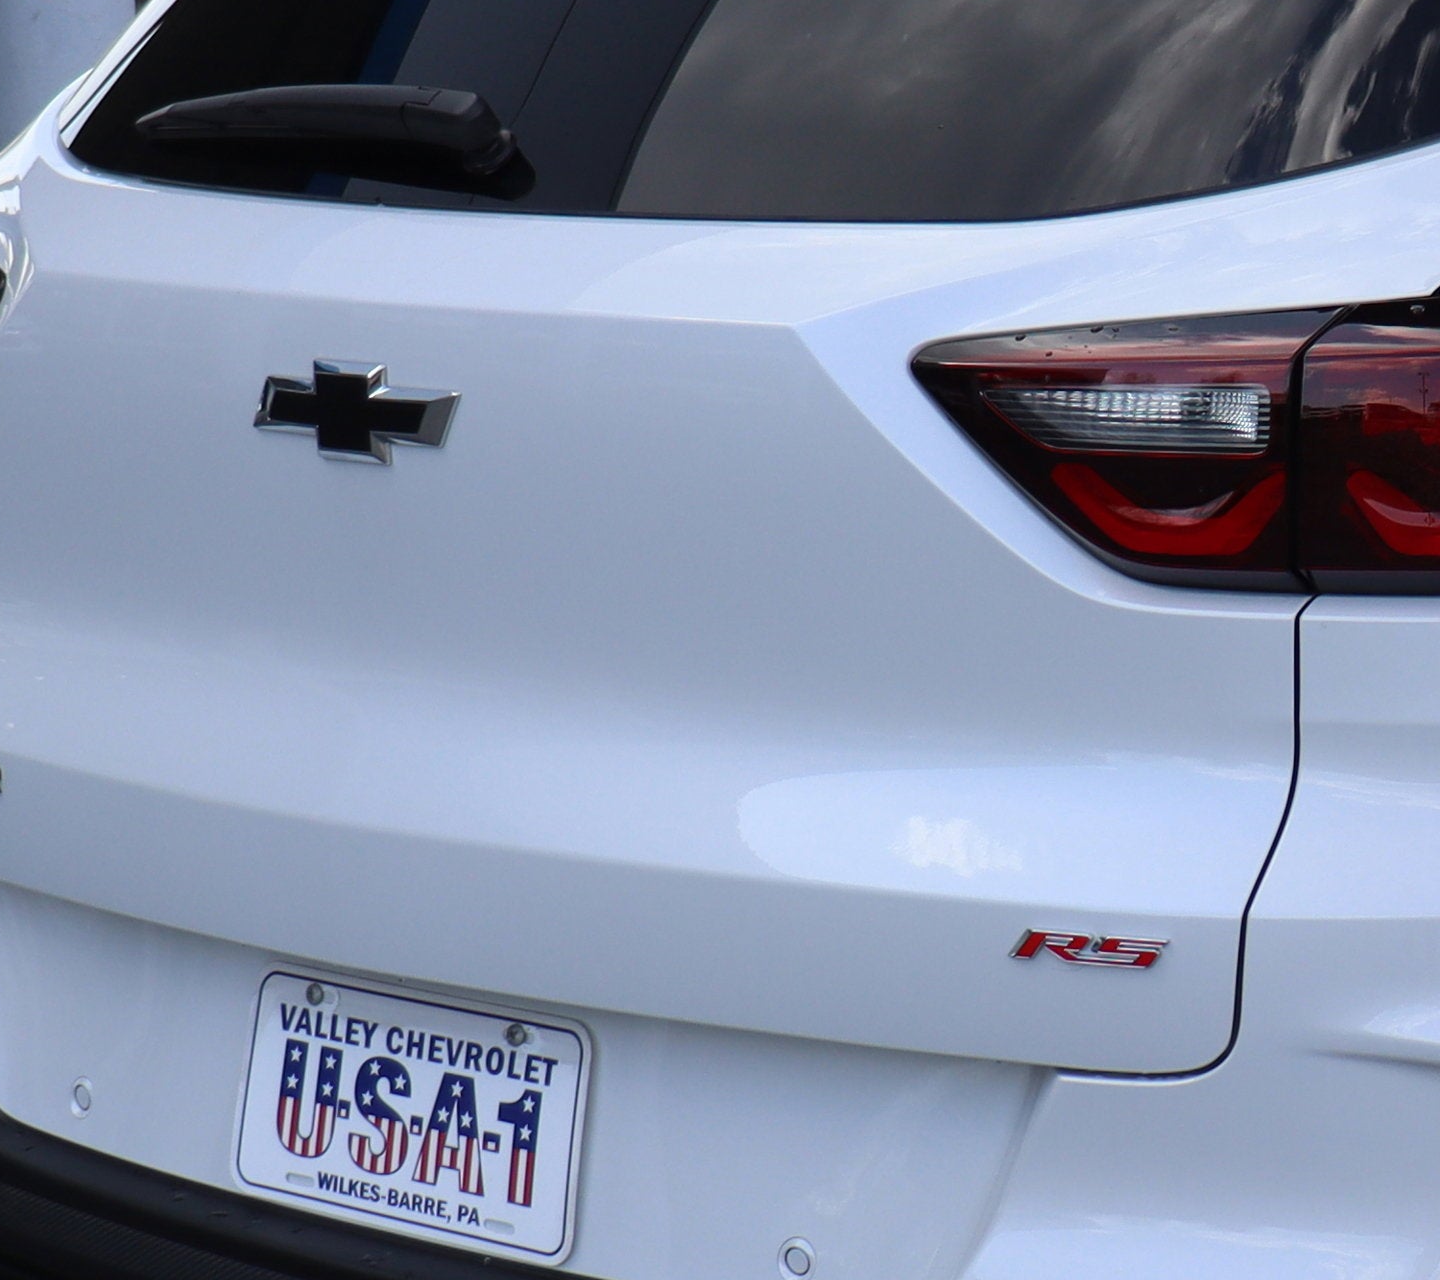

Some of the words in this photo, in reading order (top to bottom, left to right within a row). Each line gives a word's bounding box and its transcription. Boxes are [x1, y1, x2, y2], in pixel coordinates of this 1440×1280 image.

[1009, 928, 1171, 969] RS
[279, 1001, 379, 1049] VALLEY
[385, 1025, 559, 1087] CHEVROLET
[317, 1170, 452, 1224] WILKES-BARRE,
[457, 1204, 481, 1227] PA
